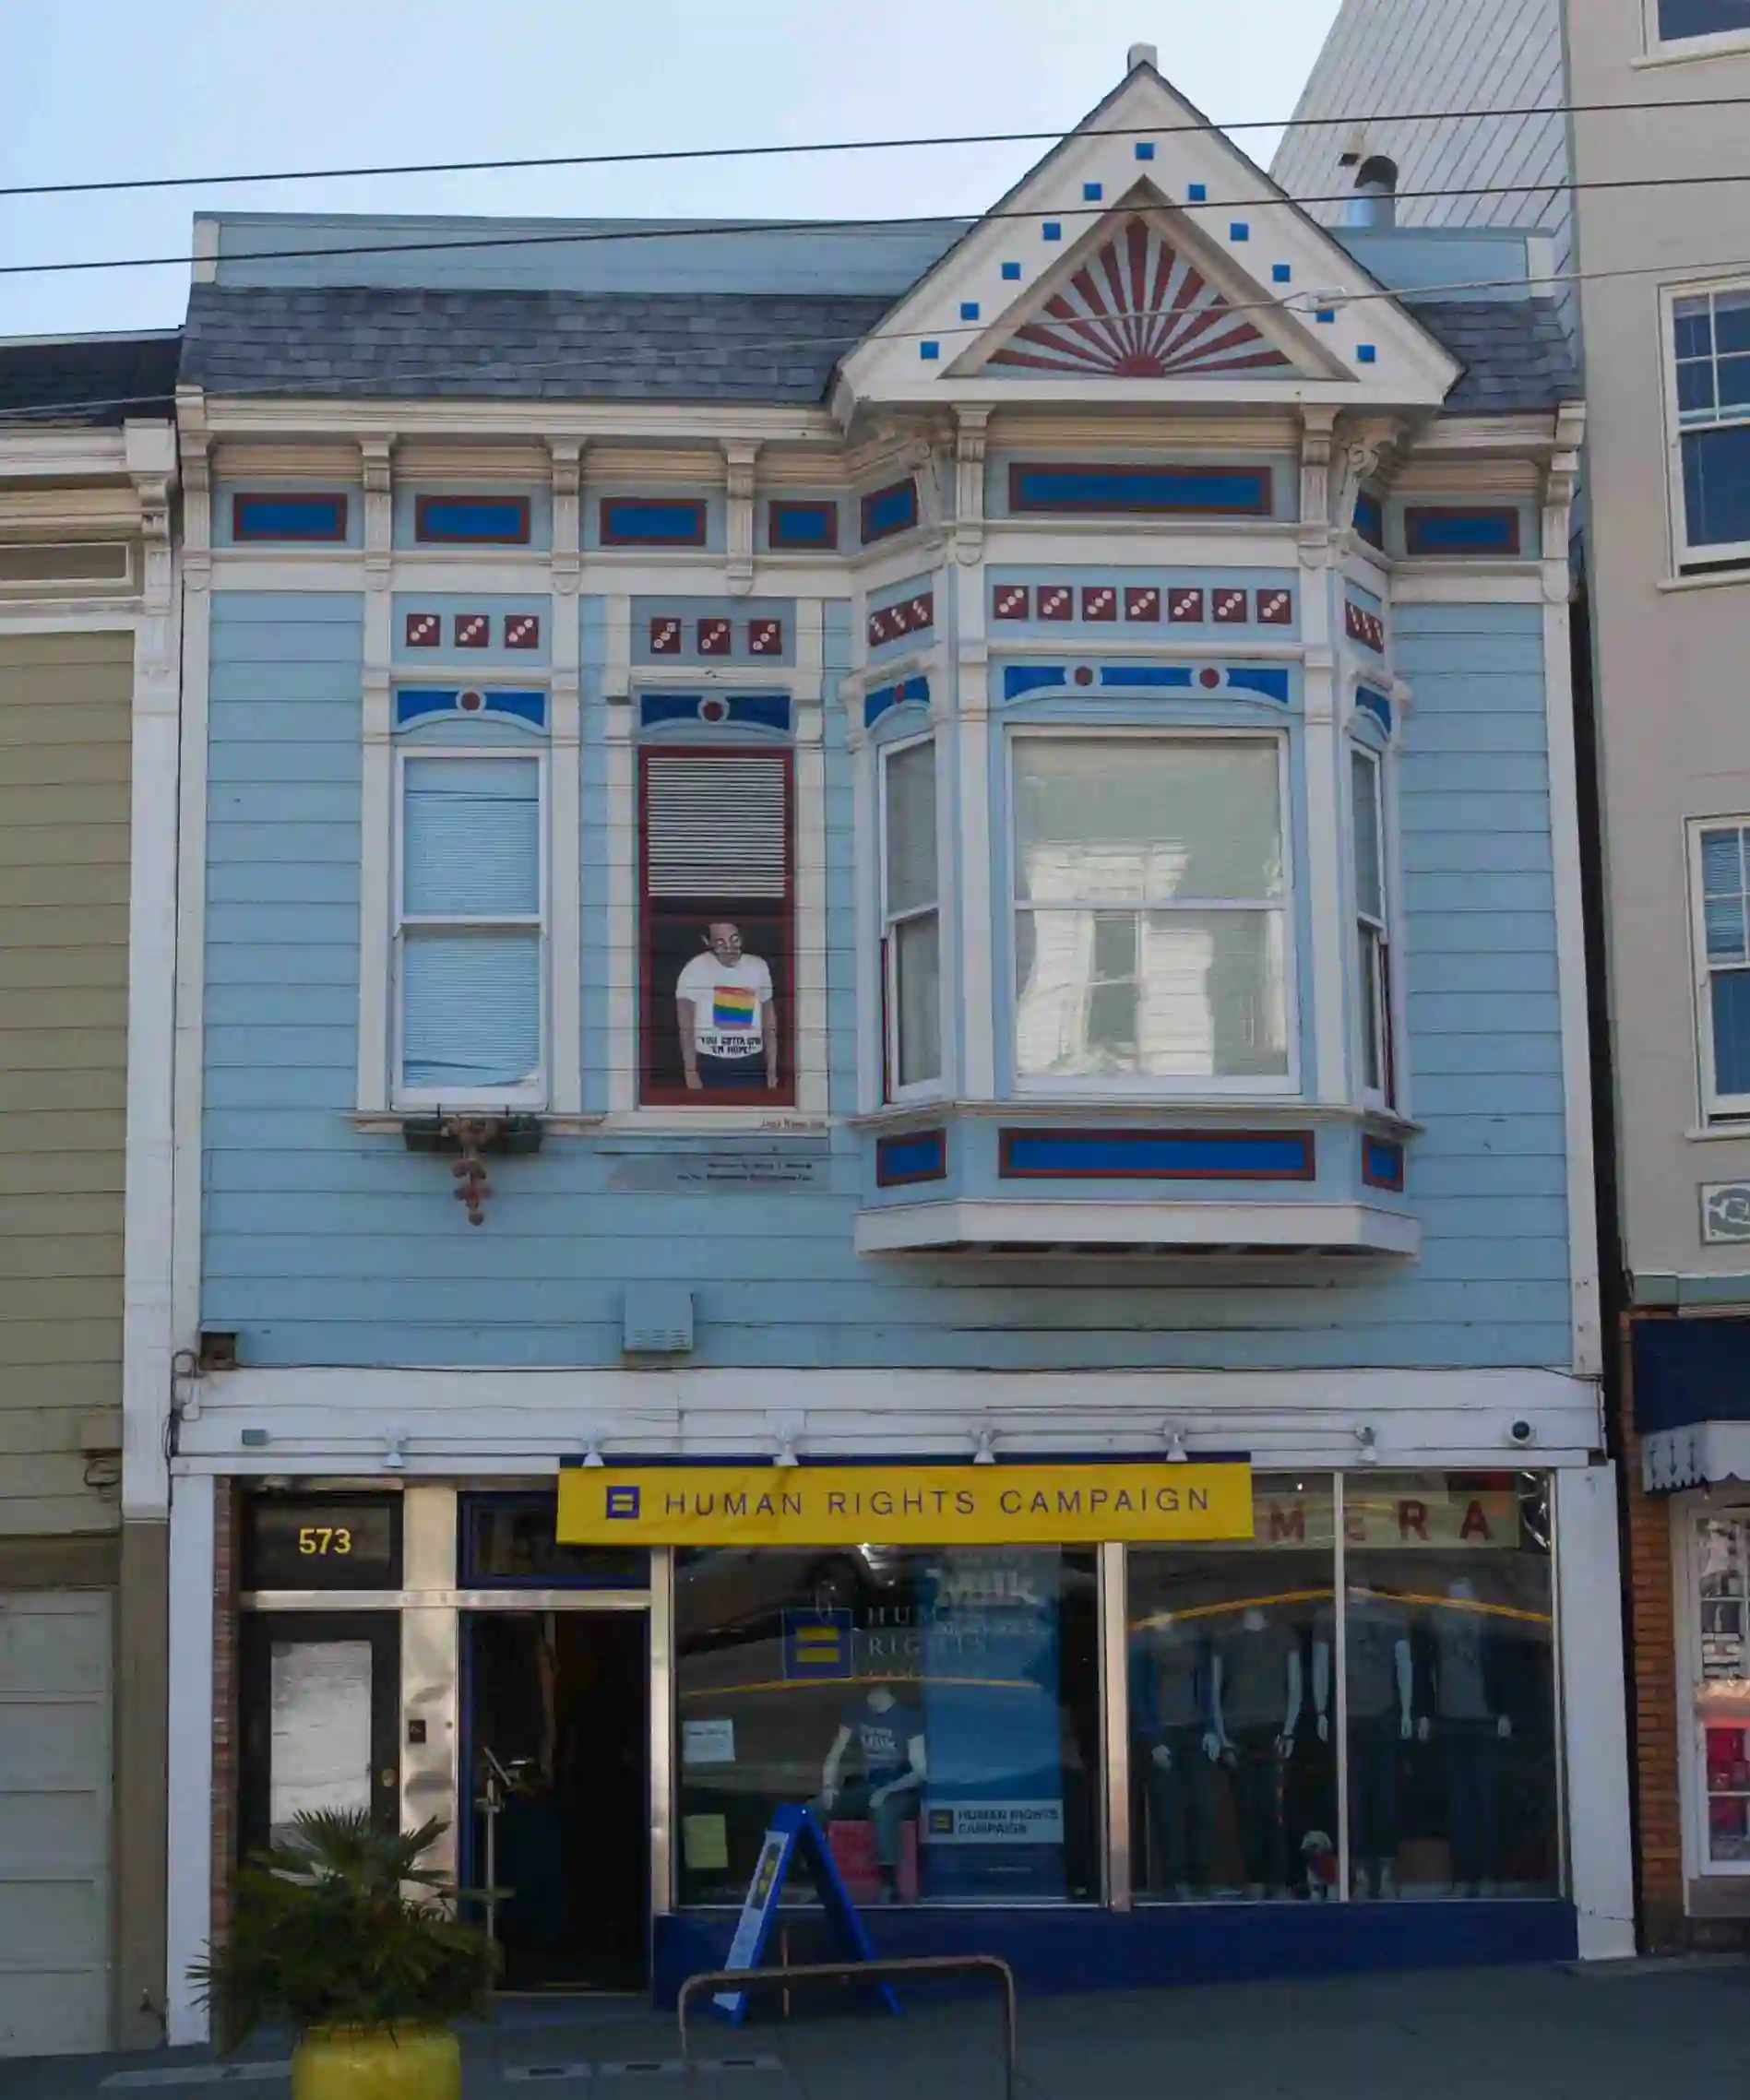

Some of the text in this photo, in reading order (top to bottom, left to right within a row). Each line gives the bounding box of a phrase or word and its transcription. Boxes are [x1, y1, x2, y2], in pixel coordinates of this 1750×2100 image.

[665, 1487, 1209, 1516] HUMAN RIGHTS CAMPAIGN
[299, 1527, 351, 1554] 573
[958, 1808, 1059, 1820] HUMAN RIGHTS
[958, 1822, 1027, 1834] CAMPAIGN
